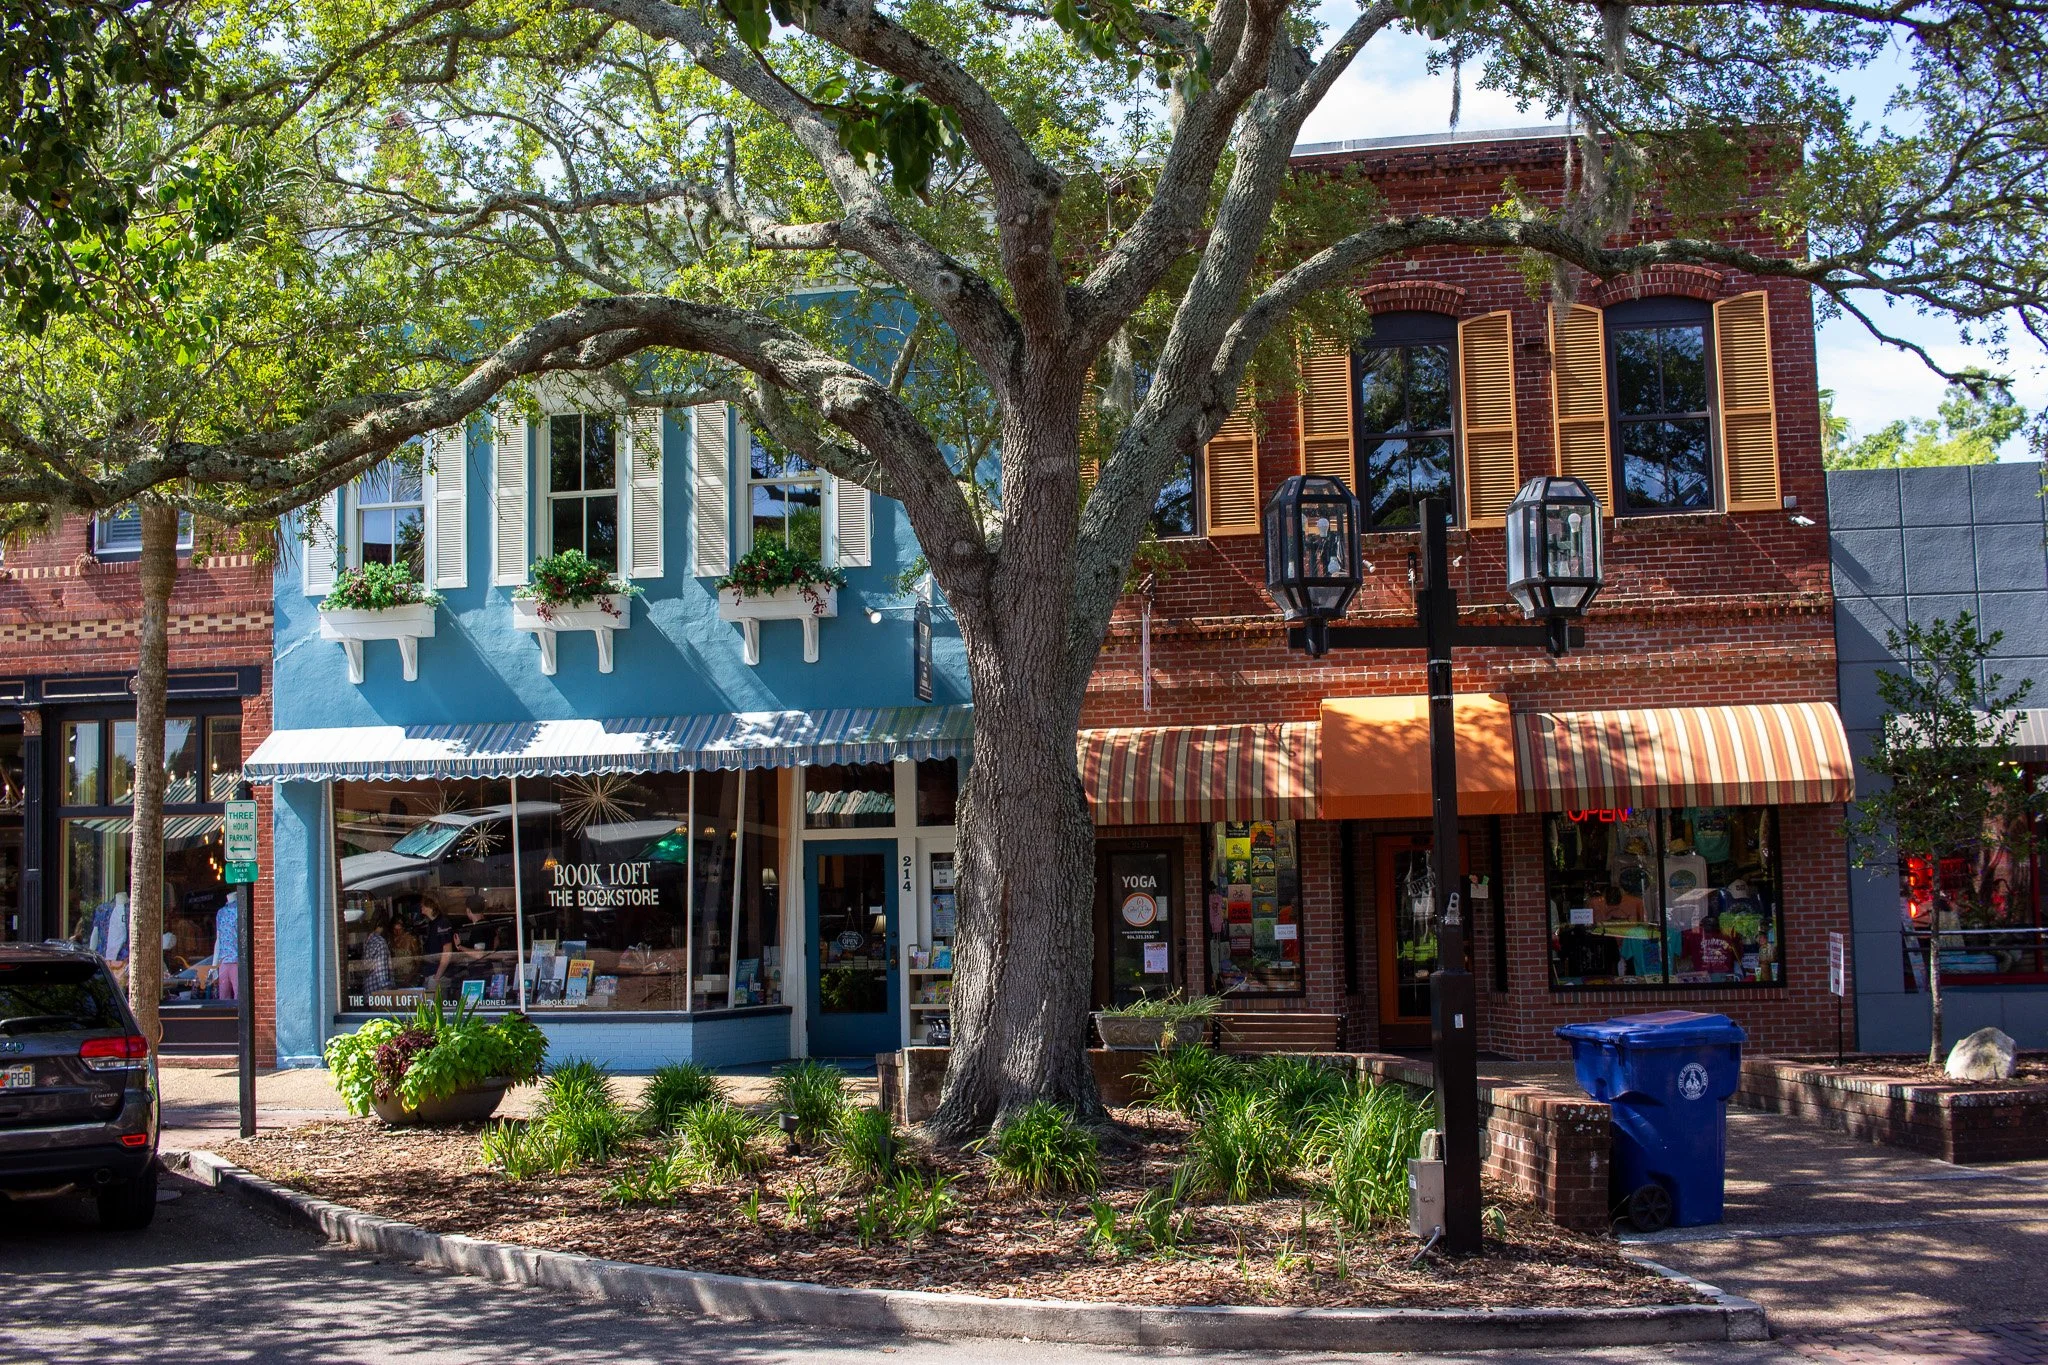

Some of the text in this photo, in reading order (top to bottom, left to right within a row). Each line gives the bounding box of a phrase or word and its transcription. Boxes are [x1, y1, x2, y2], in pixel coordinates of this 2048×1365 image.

[228, 811, 254, 820] THREE
[1567, 808, 1629, 823] OPEN
[233, 822, 249, 831] HOUR
[229, 834, 253, 842] PARKING
[553, 861, 651, 887] BOOK LOFT
[902, 855, 912, 892] 214
[1122, 875, 1157, 889] YOGA
[548, 888, 660, 907] THE BOOKSTORE
[348, 995, 364, 1007] THE
[368, 995, 393, 1007] BOOK
[396, 994, 418, 1007] LOFT
[442, 999, 458, 1007] OLD
[540, 998, 589, 1006] BOOKSTORE
[11, 1072, 30, 1086] P68
